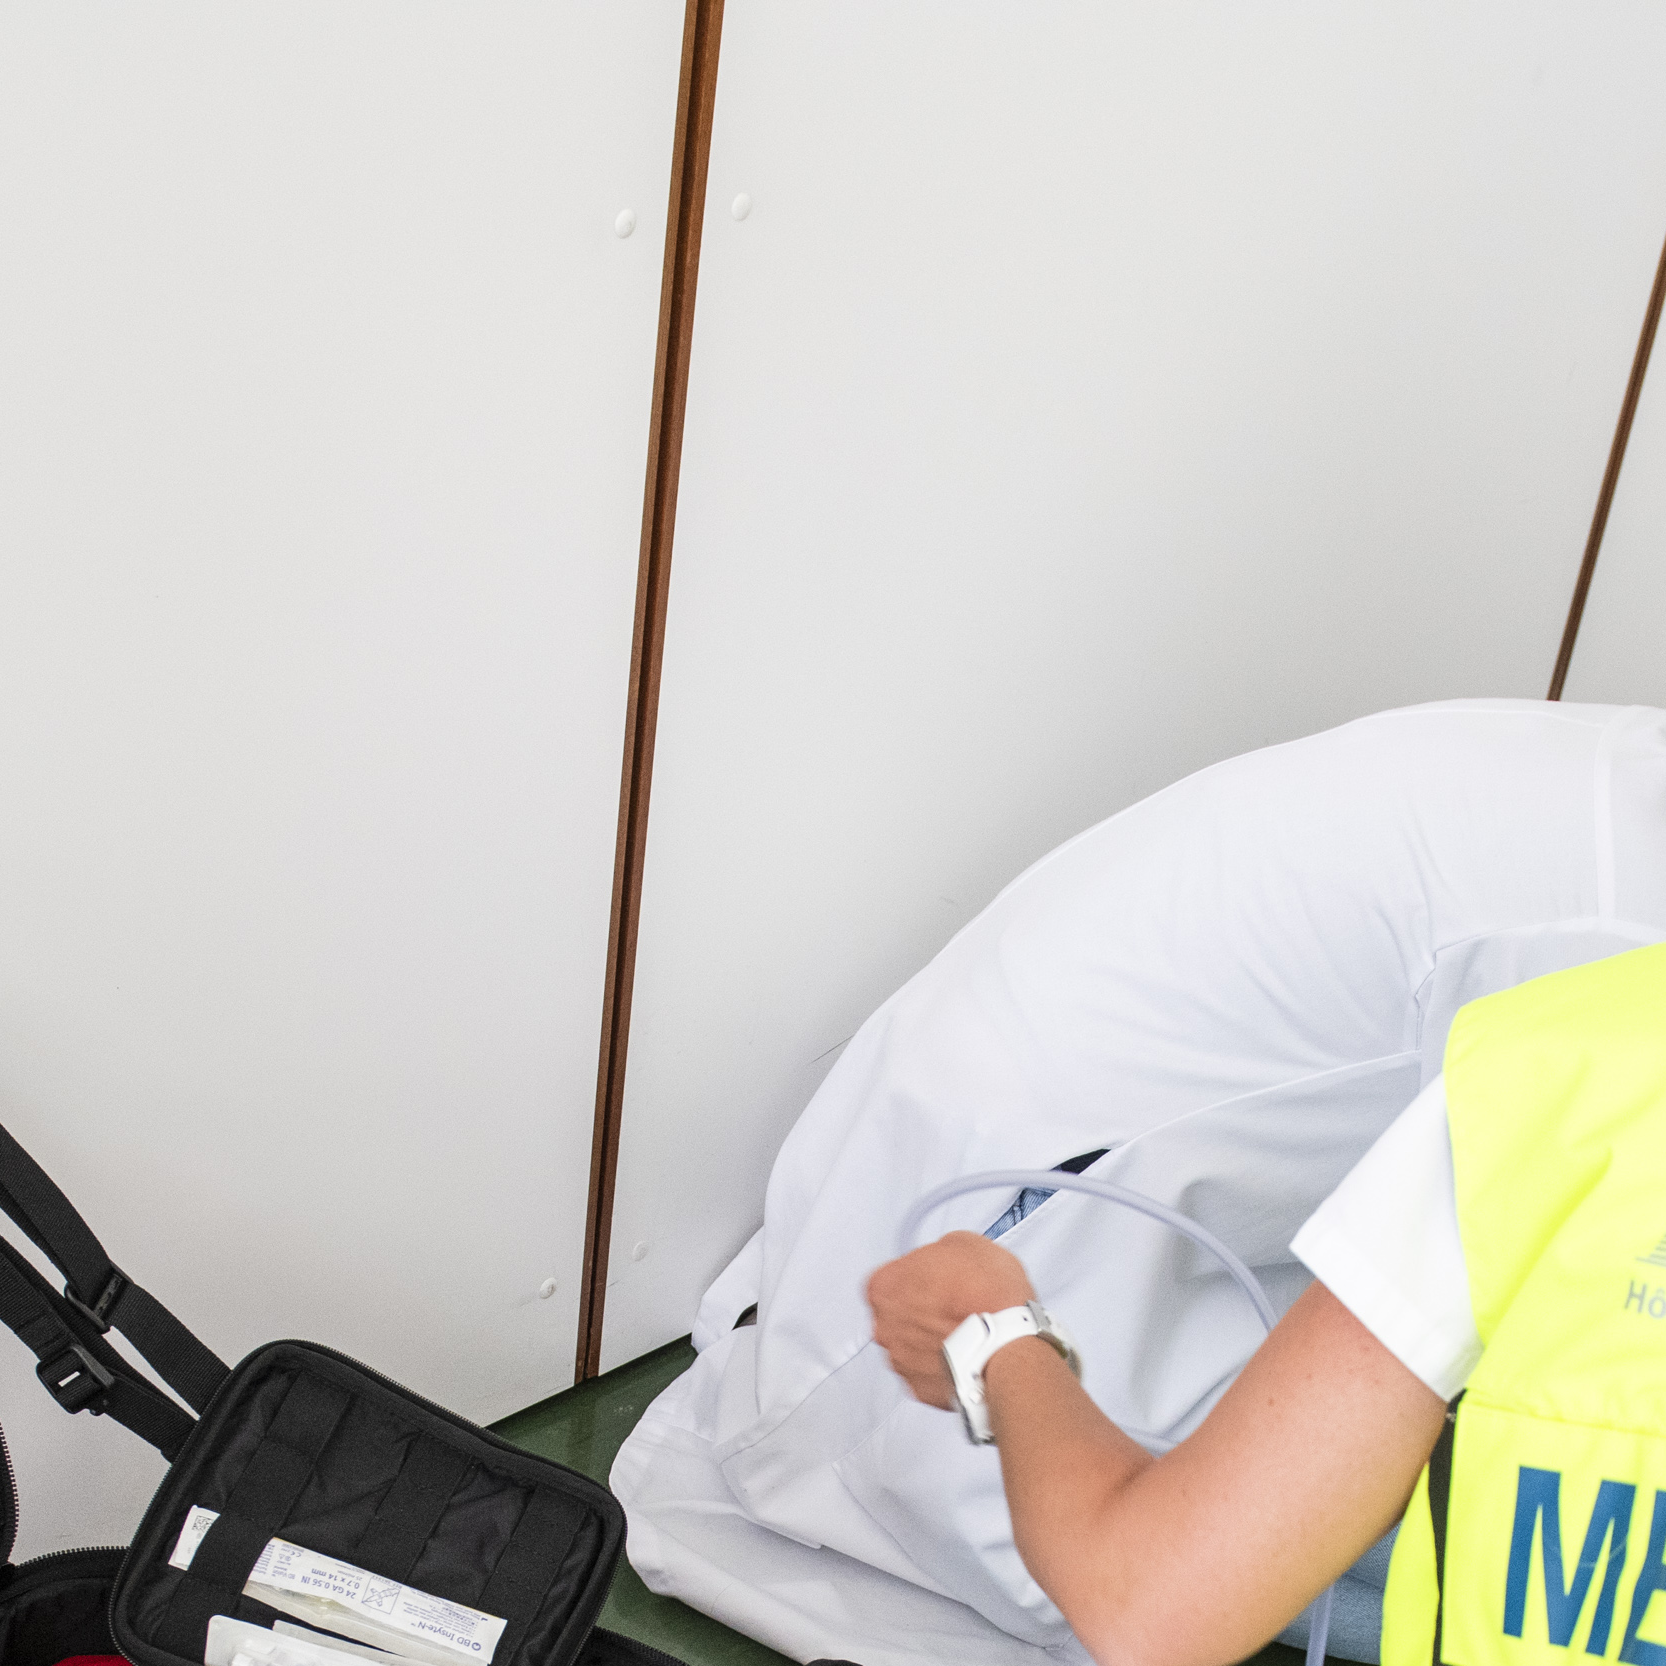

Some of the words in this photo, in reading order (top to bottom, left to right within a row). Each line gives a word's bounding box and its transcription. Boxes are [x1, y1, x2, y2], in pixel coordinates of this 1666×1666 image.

[310, 1567, 326, 1577] mm
[300, 1574, 310, 1584] IN
[327, 1573, 337, 1582] 14
[311, 1577, 330, 1590] 0.56
[330, 1583, 344, 1594] GA
[346, 1579, 360, 1589] 0.7
[344, 1589, 356, 1599] 24
[456, 1635, 471, 1647] BD
